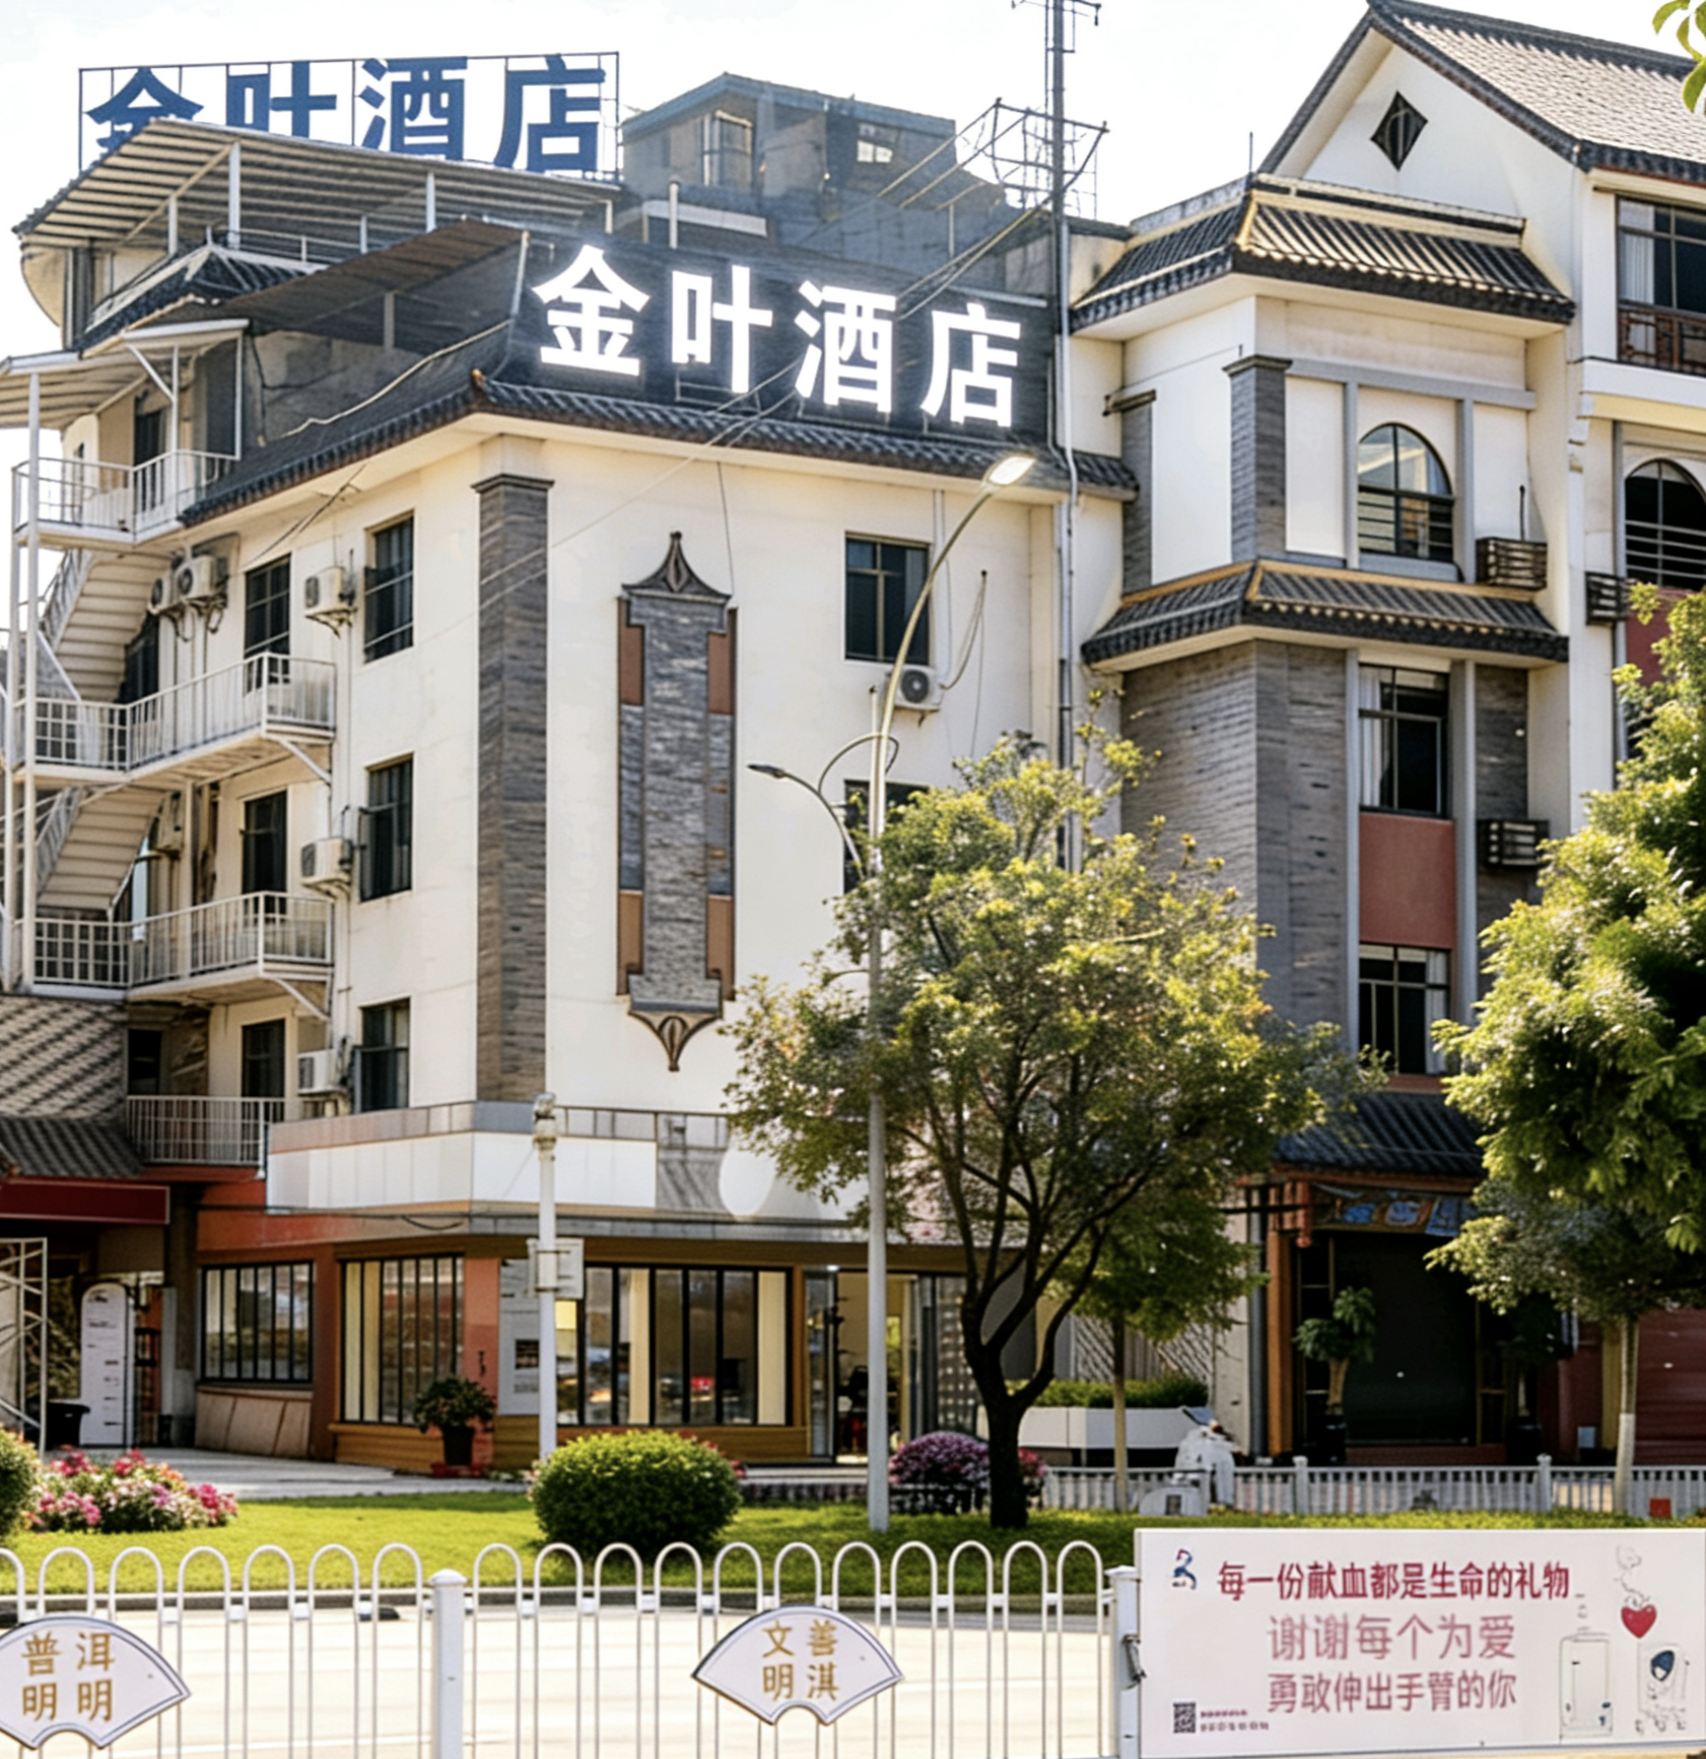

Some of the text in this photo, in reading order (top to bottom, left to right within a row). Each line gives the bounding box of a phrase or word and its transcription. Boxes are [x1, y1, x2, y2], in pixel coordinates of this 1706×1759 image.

[532, 244, 1021, 427] 金叶酒店
[1218, 1561, 1570, 1601] 每一份献血都是生命的礼物
[1267, 1613, 1516, 1661] 谢谢每个为爱
[1267, 1669, 1517, 1713] 勇敢伸出手臂的你
